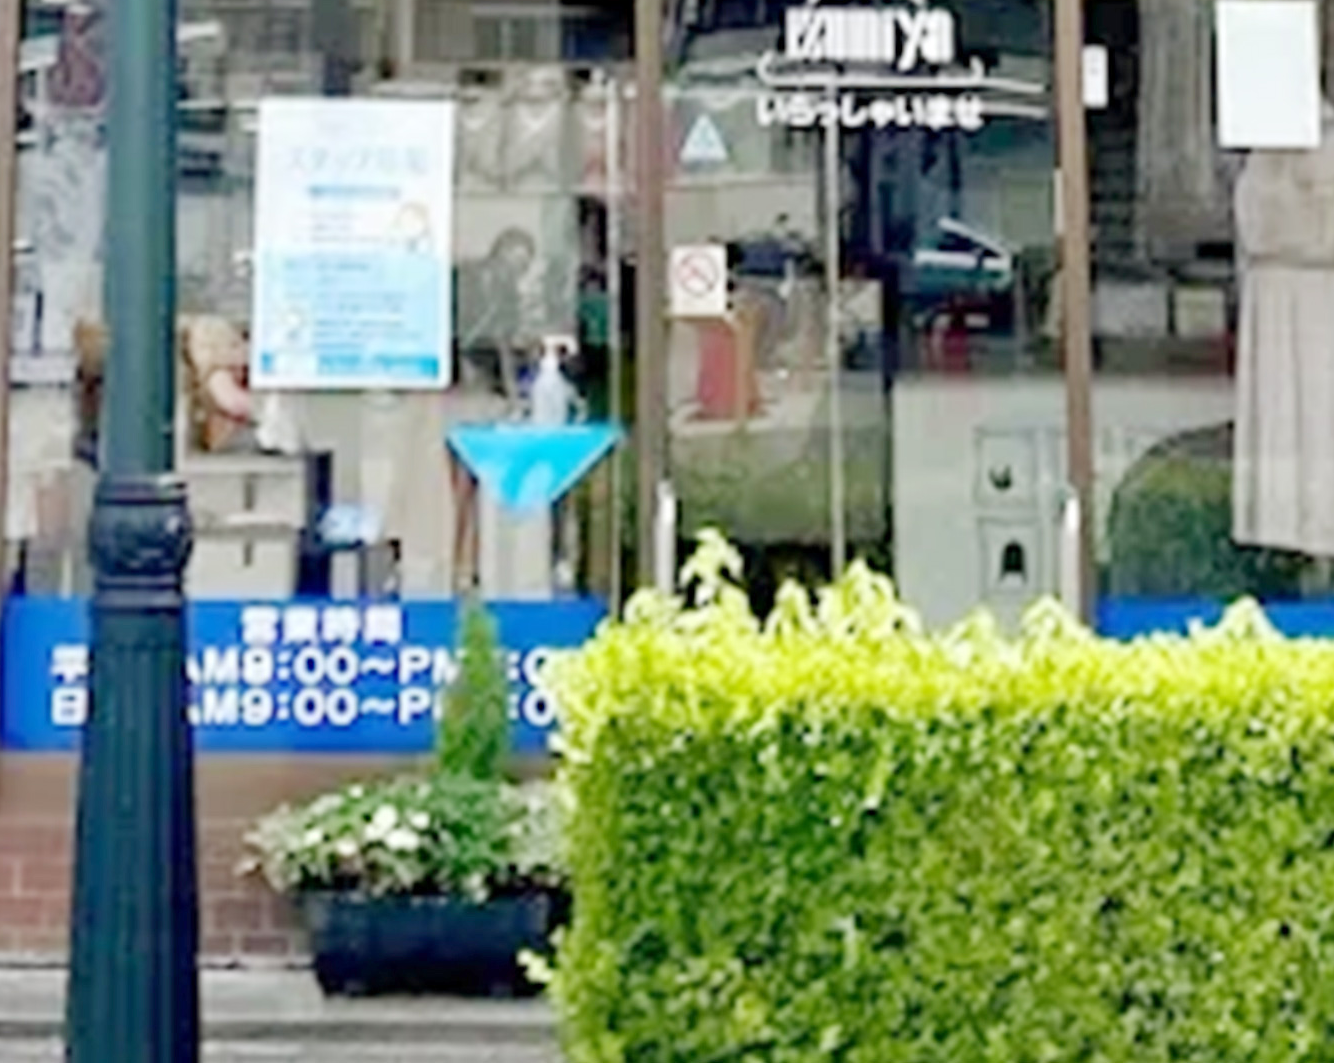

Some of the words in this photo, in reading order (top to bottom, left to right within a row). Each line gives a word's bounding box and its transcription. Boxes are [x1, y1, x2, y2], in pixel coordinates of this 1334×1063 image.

[756, 93, 986, 130] いらっしゃいませ
[240, 605, 404, 646] 営業時間
